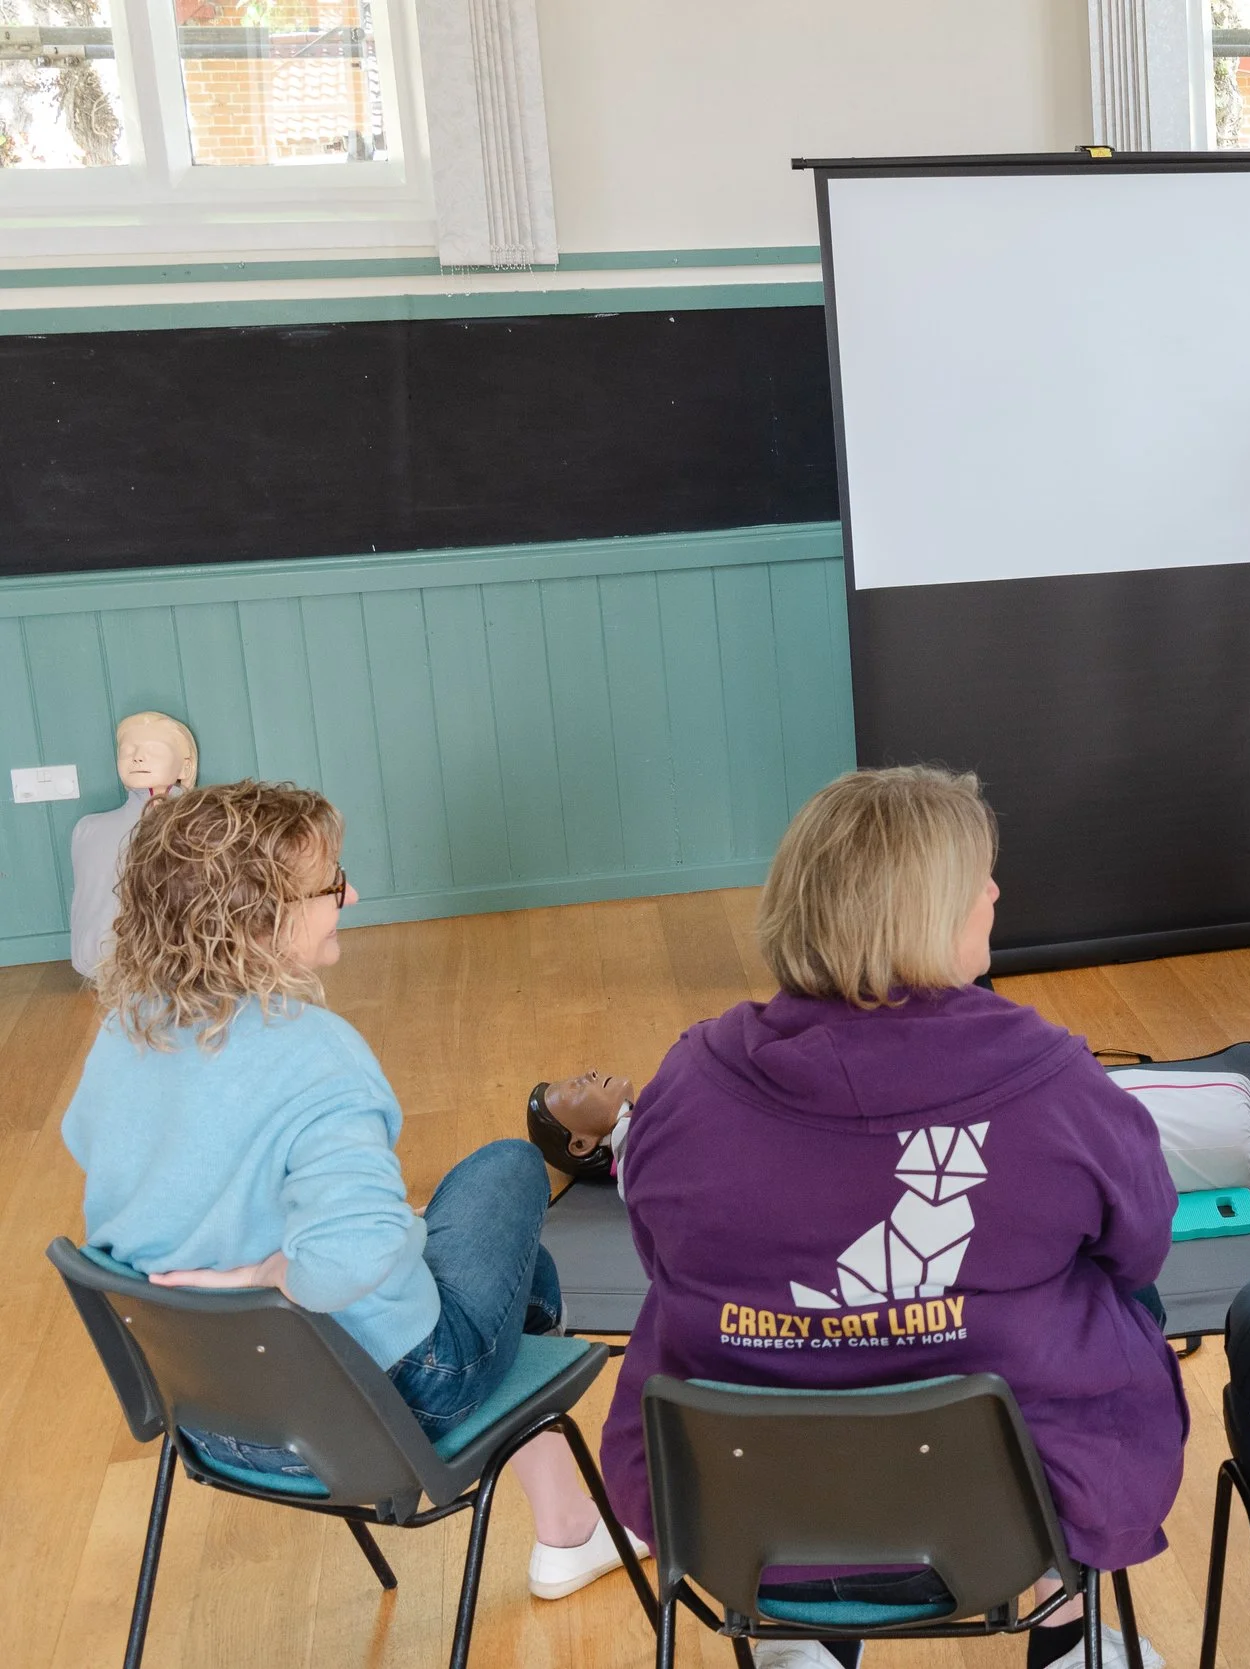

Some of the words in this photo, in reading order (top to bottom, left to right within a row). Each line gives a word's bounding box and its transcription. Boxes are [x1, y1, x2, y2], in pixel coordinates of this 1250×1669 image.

[720, 1302, 812, 1337] CRAZY
[821, 1312, 879, 1338] CAT
[888, 1296, 965, 1336] LADY
[721, 1335, 804, 1348] PURRFECT
[811, 1338, 841, 1348] CAT
[848, 1336, 889, 1347] CARE
[896, 1336, 915, 1346] AT
[922, 1328, 968, 1344] HOME
